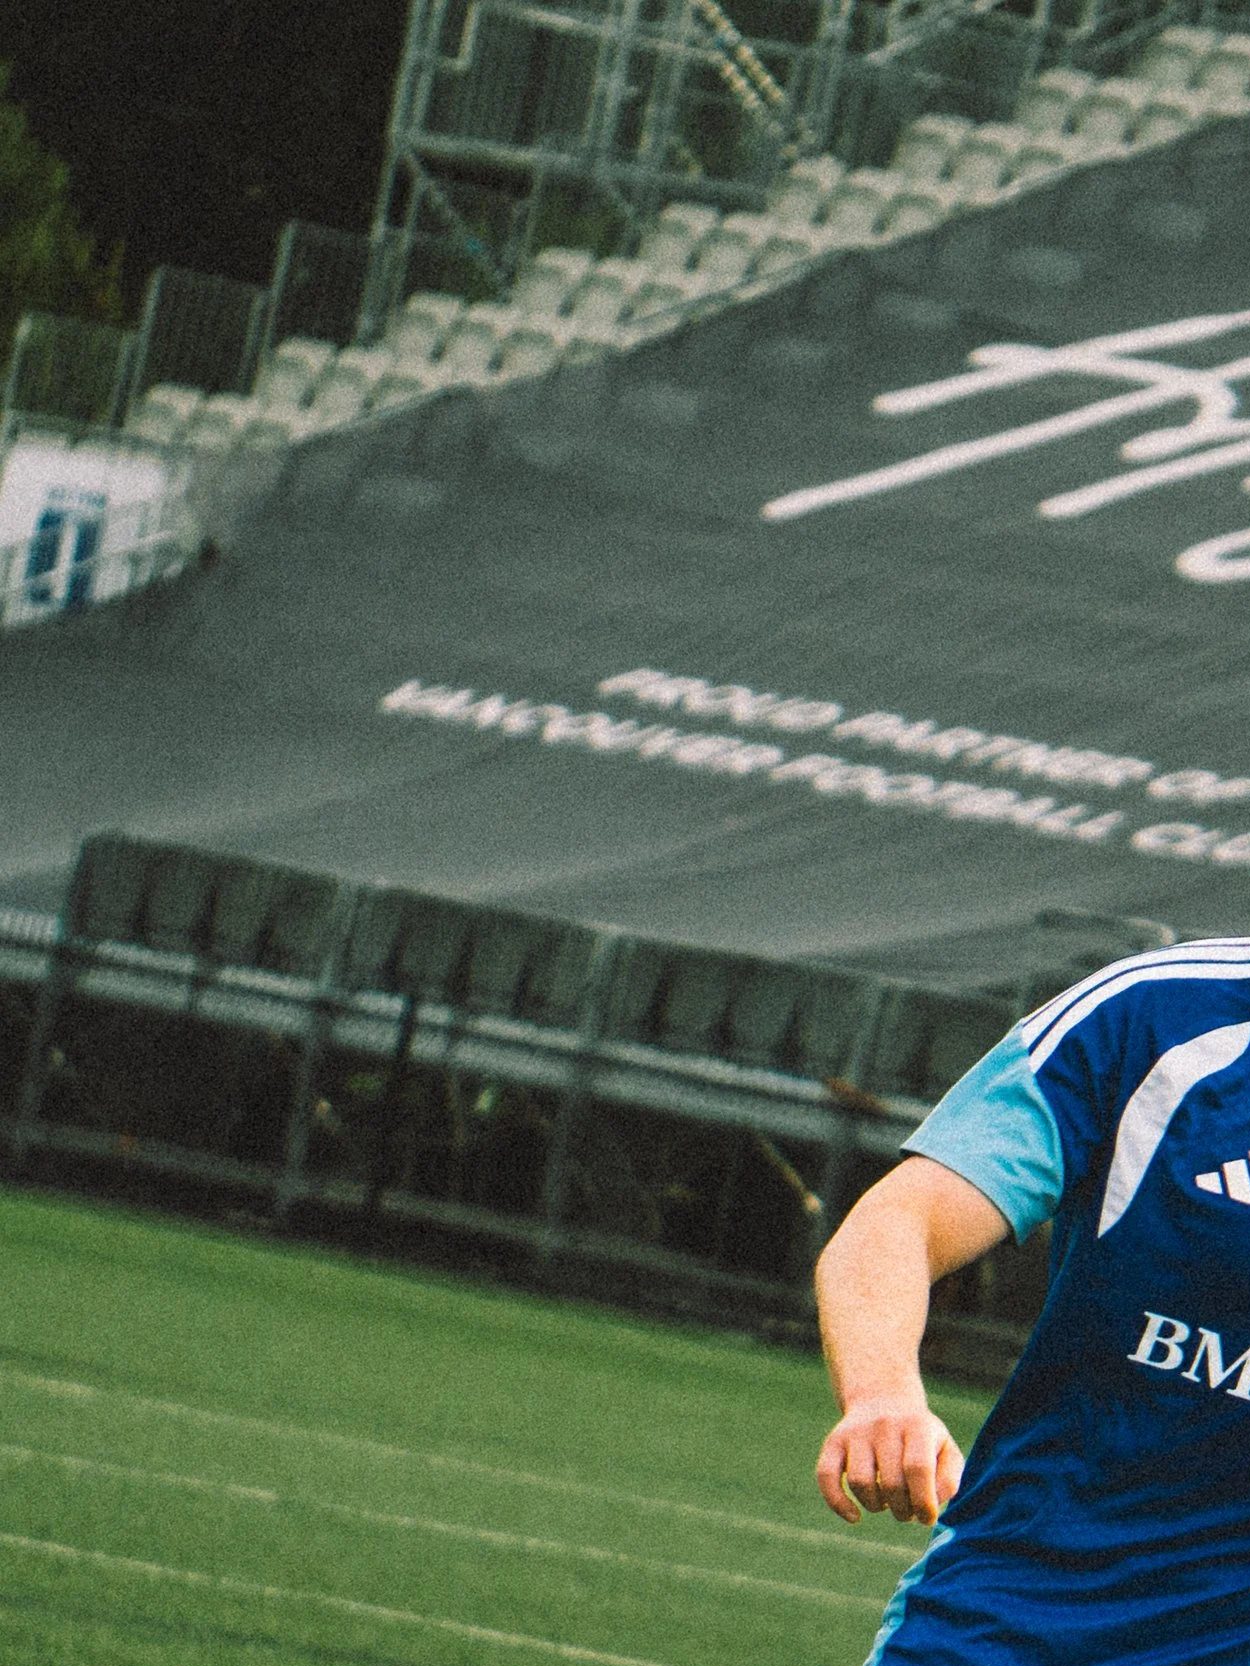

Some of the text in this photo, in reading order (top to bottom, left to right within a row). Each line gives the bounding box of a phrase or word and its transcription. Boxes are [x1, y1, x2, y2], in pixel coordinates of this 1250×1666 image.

[600, 669, 842, 732] PROUD
[381, 680, 785, 775] VANCOUVER
[769, 754, 1126, 842] FOOTBALL
